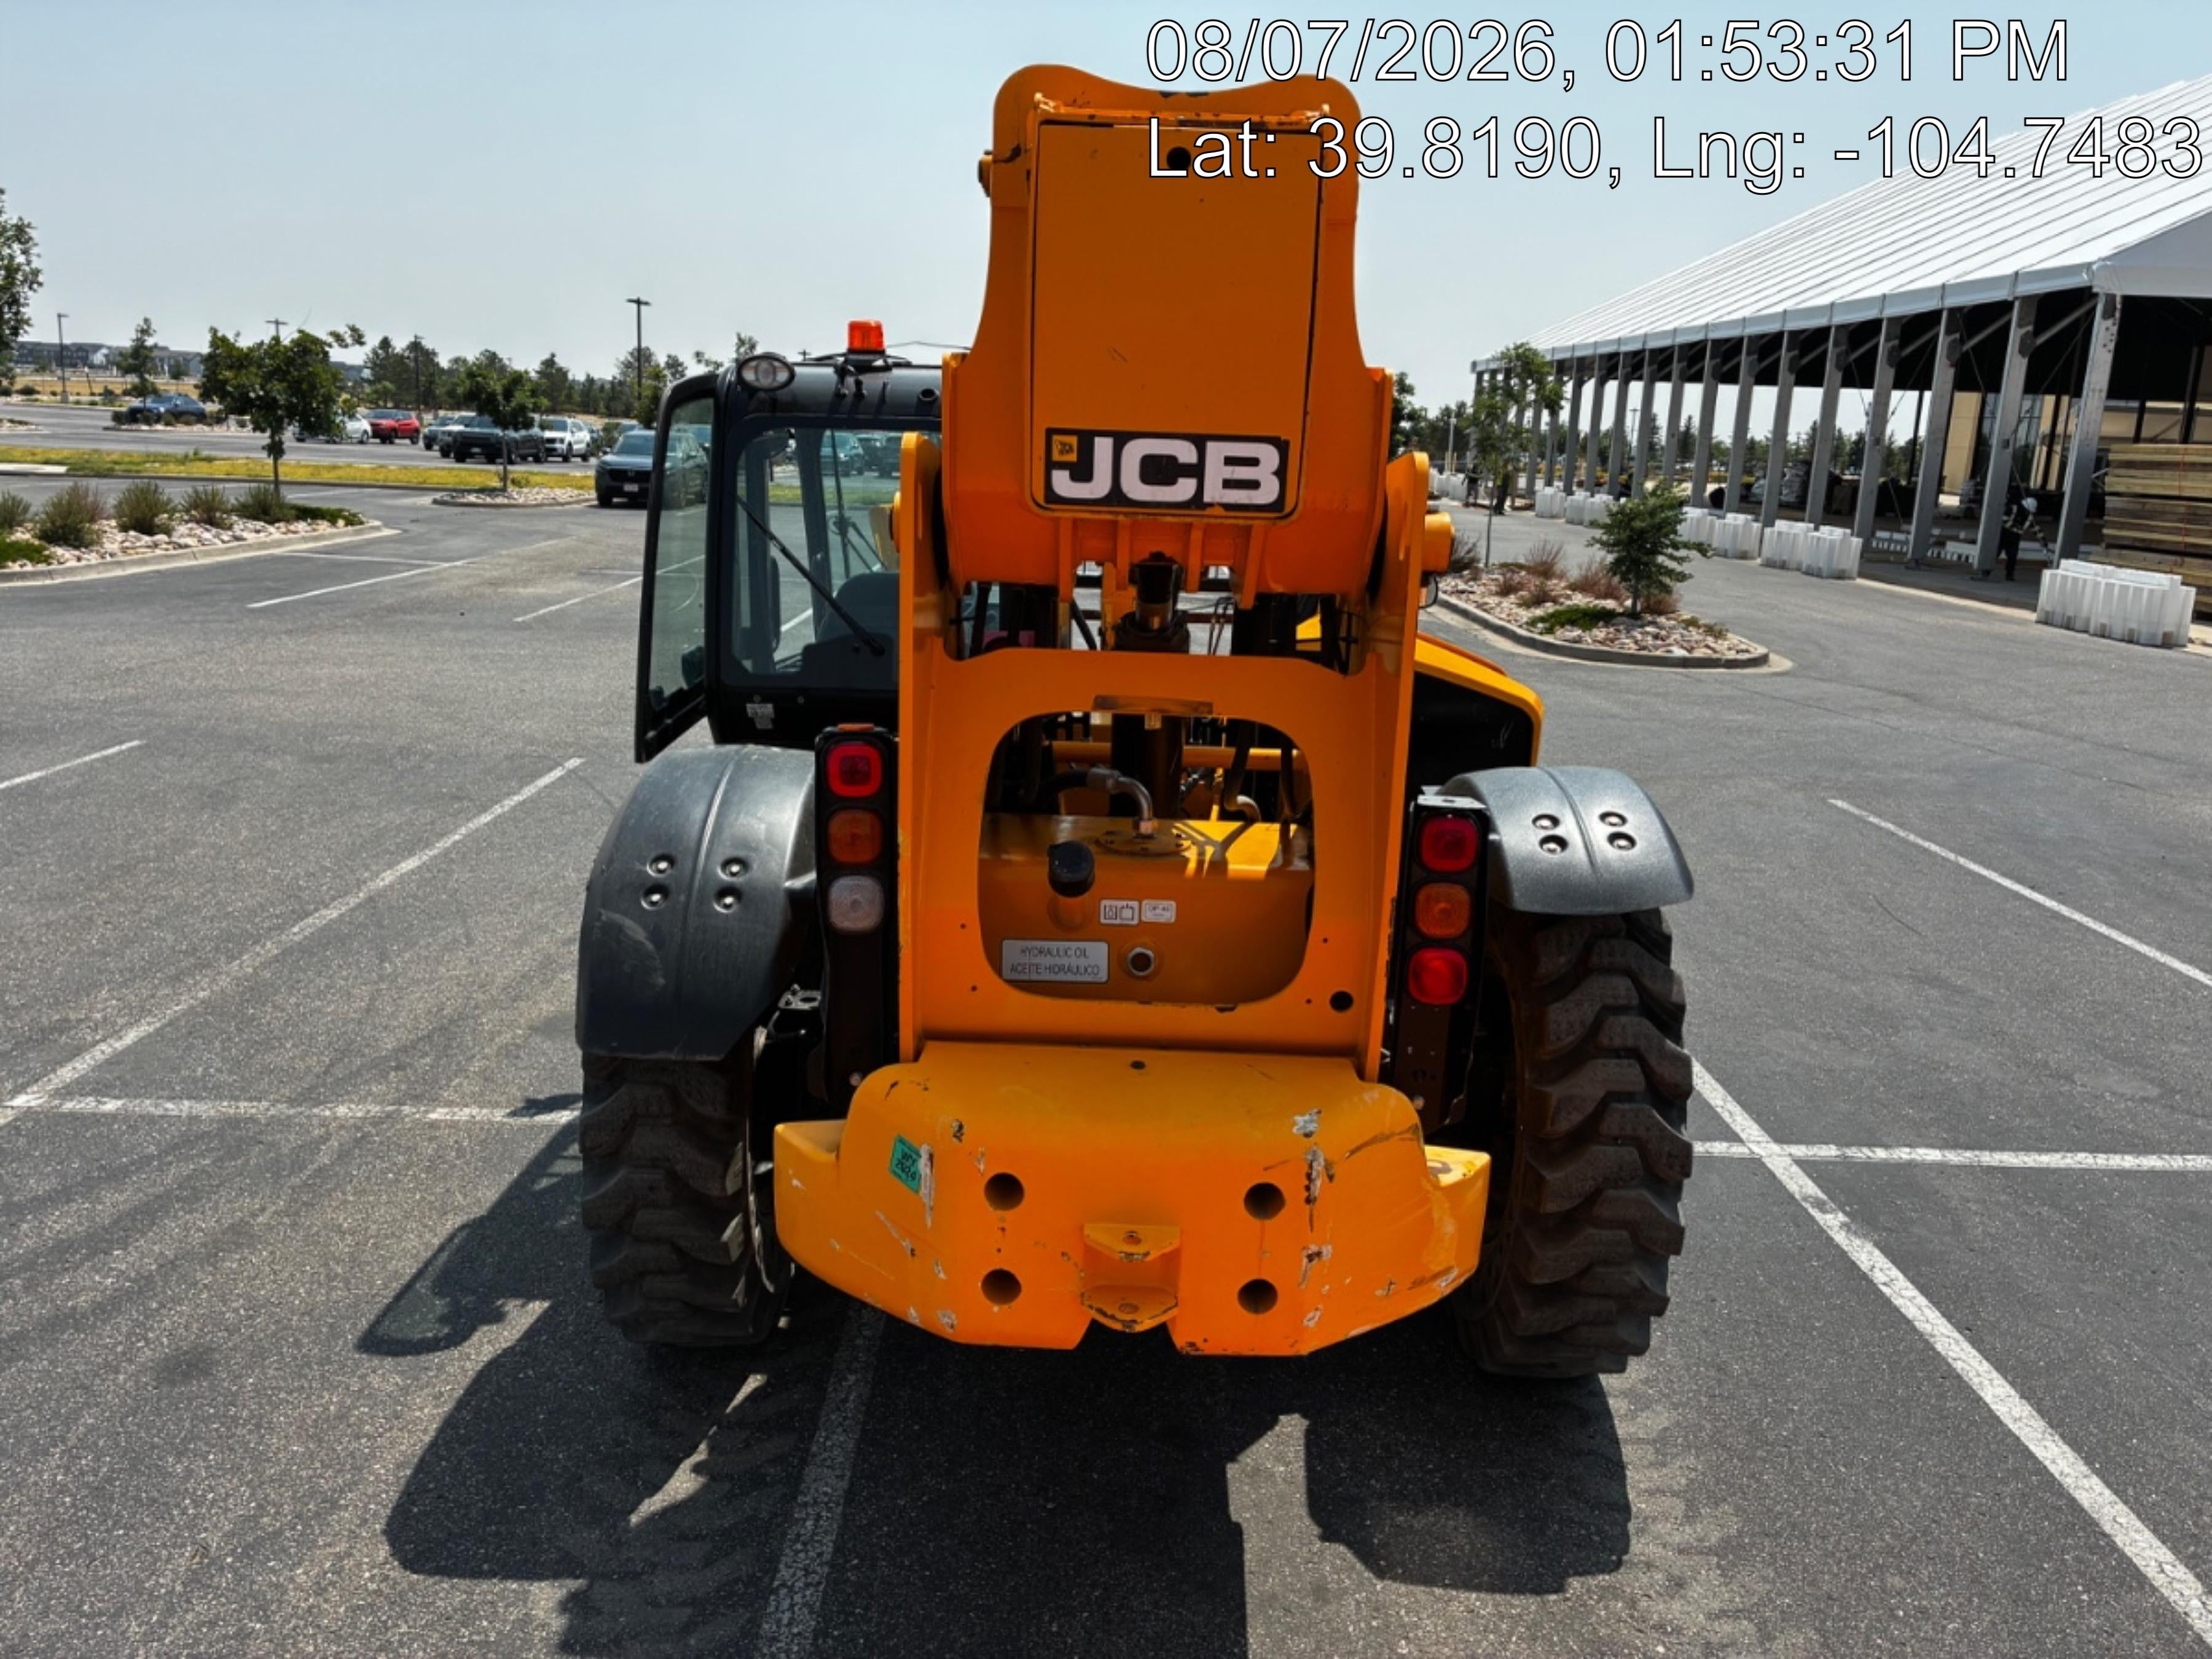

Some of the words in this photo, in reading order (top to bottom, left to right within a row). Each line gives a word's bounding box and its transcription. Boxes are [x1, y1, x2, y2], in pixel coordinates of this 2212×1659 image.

[1051, 436, 1281, 506] JCB
[1021, 946, 1072, 959] HYDRAULIC
[1010, 962, 1043, 975] ACEITE
